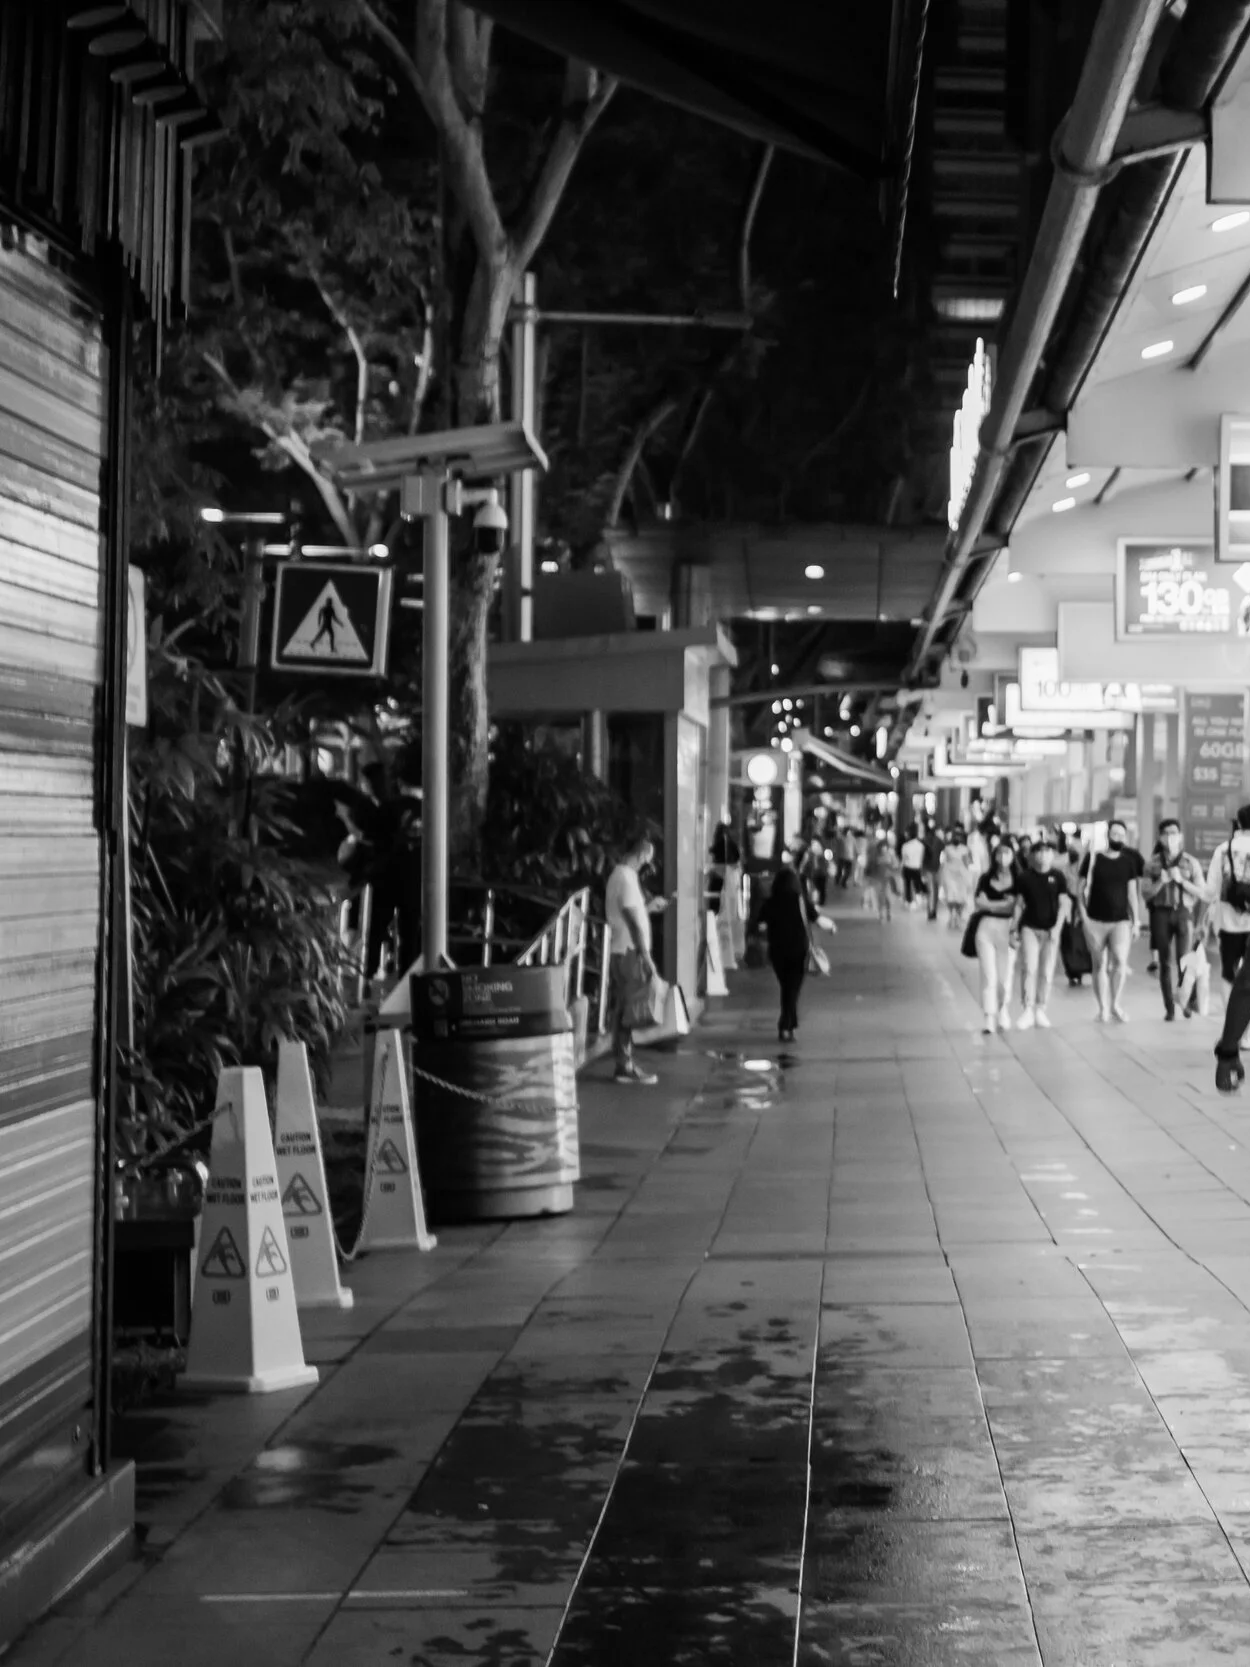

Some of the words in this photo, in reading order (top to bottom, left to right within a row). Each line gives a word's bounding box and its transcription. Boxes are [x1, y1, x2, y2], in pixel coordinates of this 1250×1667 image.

[280, 1131, 312, 1144] CAUTION
[276, 1146, 290, 1157] WET
[292, 1144, 317, 1156] FLOOR
[252, 1175, 275, 1188] CAUTION
[250, 1191, 261, 1204] WET
[261, 1189, 279, 1202] FLOOR
